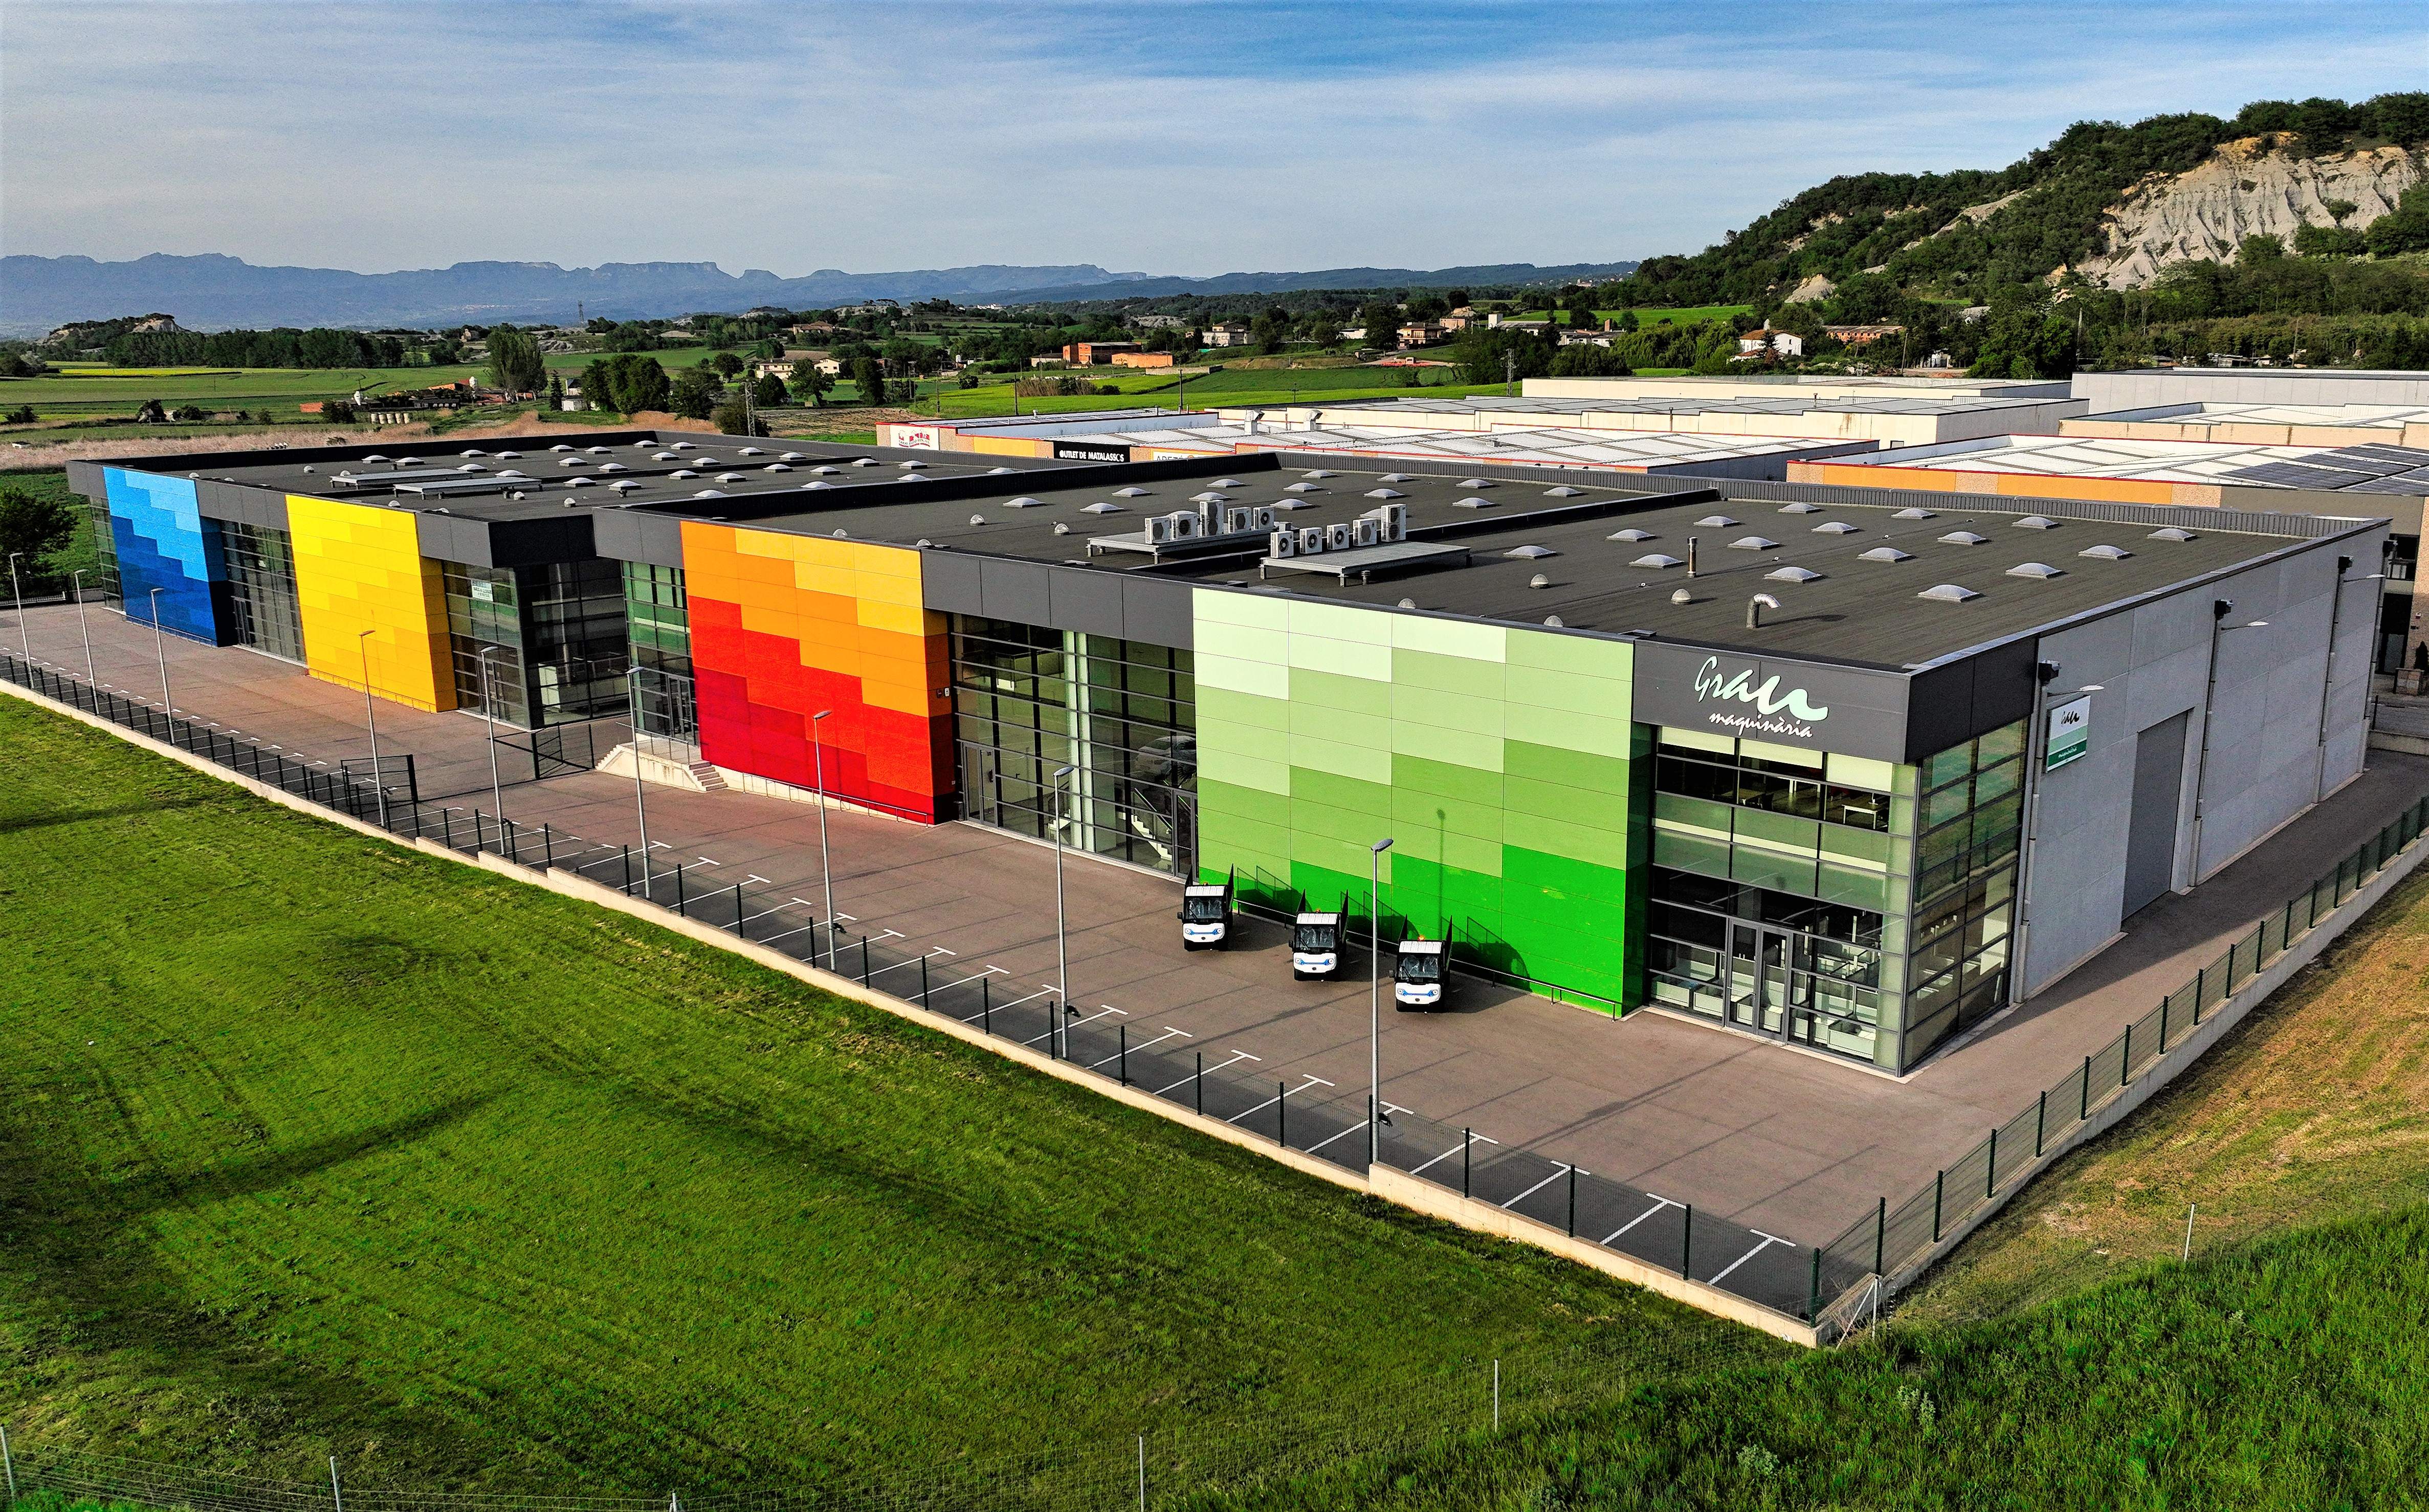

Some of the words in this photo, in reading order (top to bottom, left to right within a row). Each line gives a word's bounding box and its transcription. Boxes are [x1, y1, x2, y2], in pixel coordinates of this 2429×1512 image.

[1059, 450, 1078, 459] OUTLET
[1079, 451, 1087, 459] DE
[1088, 452, 1124, 462] MATALASSOS
[1694, 656, 1828, 721] Gran
[1709, 713, 1813, 738] maquinària
